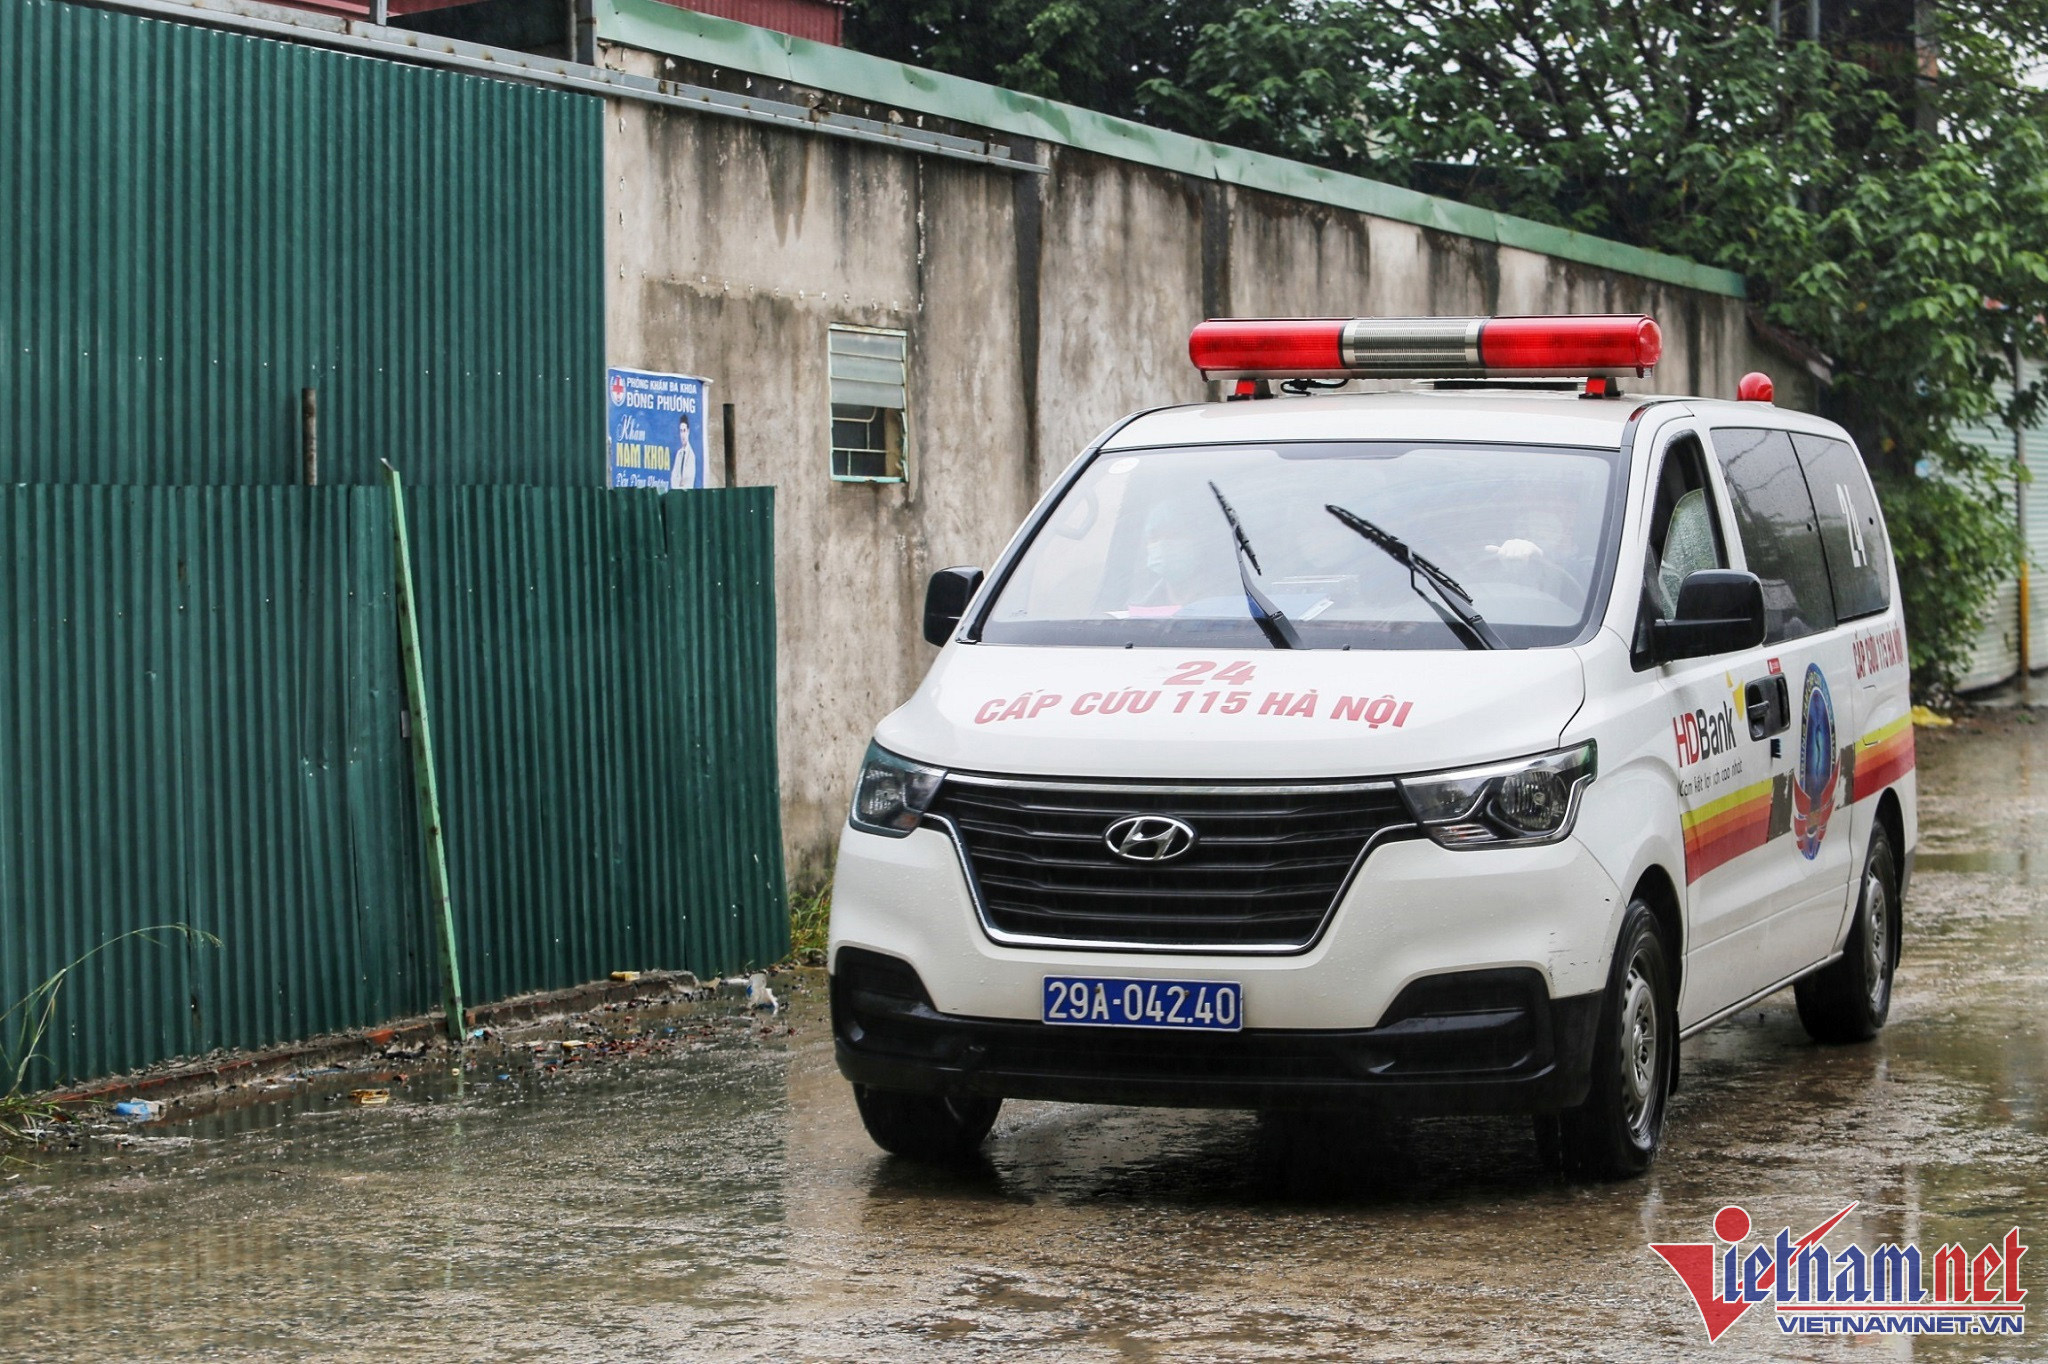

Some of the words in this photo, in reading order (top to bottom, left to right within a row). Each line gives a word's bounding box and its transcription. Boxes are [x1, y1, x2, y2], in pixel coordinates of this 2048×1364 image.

[626, 390, 654, 409] ĐÔNG
[657, 395, 696, 413] PHƯƠNG
[679, 383, 697, 394] KHOA
[616, 442, 641, 468] NAM
[644, 444, 671, 471] KHOA
[1836, 483, 1868, 568] 24
[1161, 660, 1259, 686] 24
[973, 688, 1063, 726] CẤP
[1070, 686, 1162, 716] CỨU
[1172, 690, 1253, 715] 115
[1257, 688, 1321, 719] HÀ
[1329, 694, 1415, 730] NỘI
[1673, 700, 1737, 768] HDBank
[1048, 981, 1236, 1025] 29A-042.40
